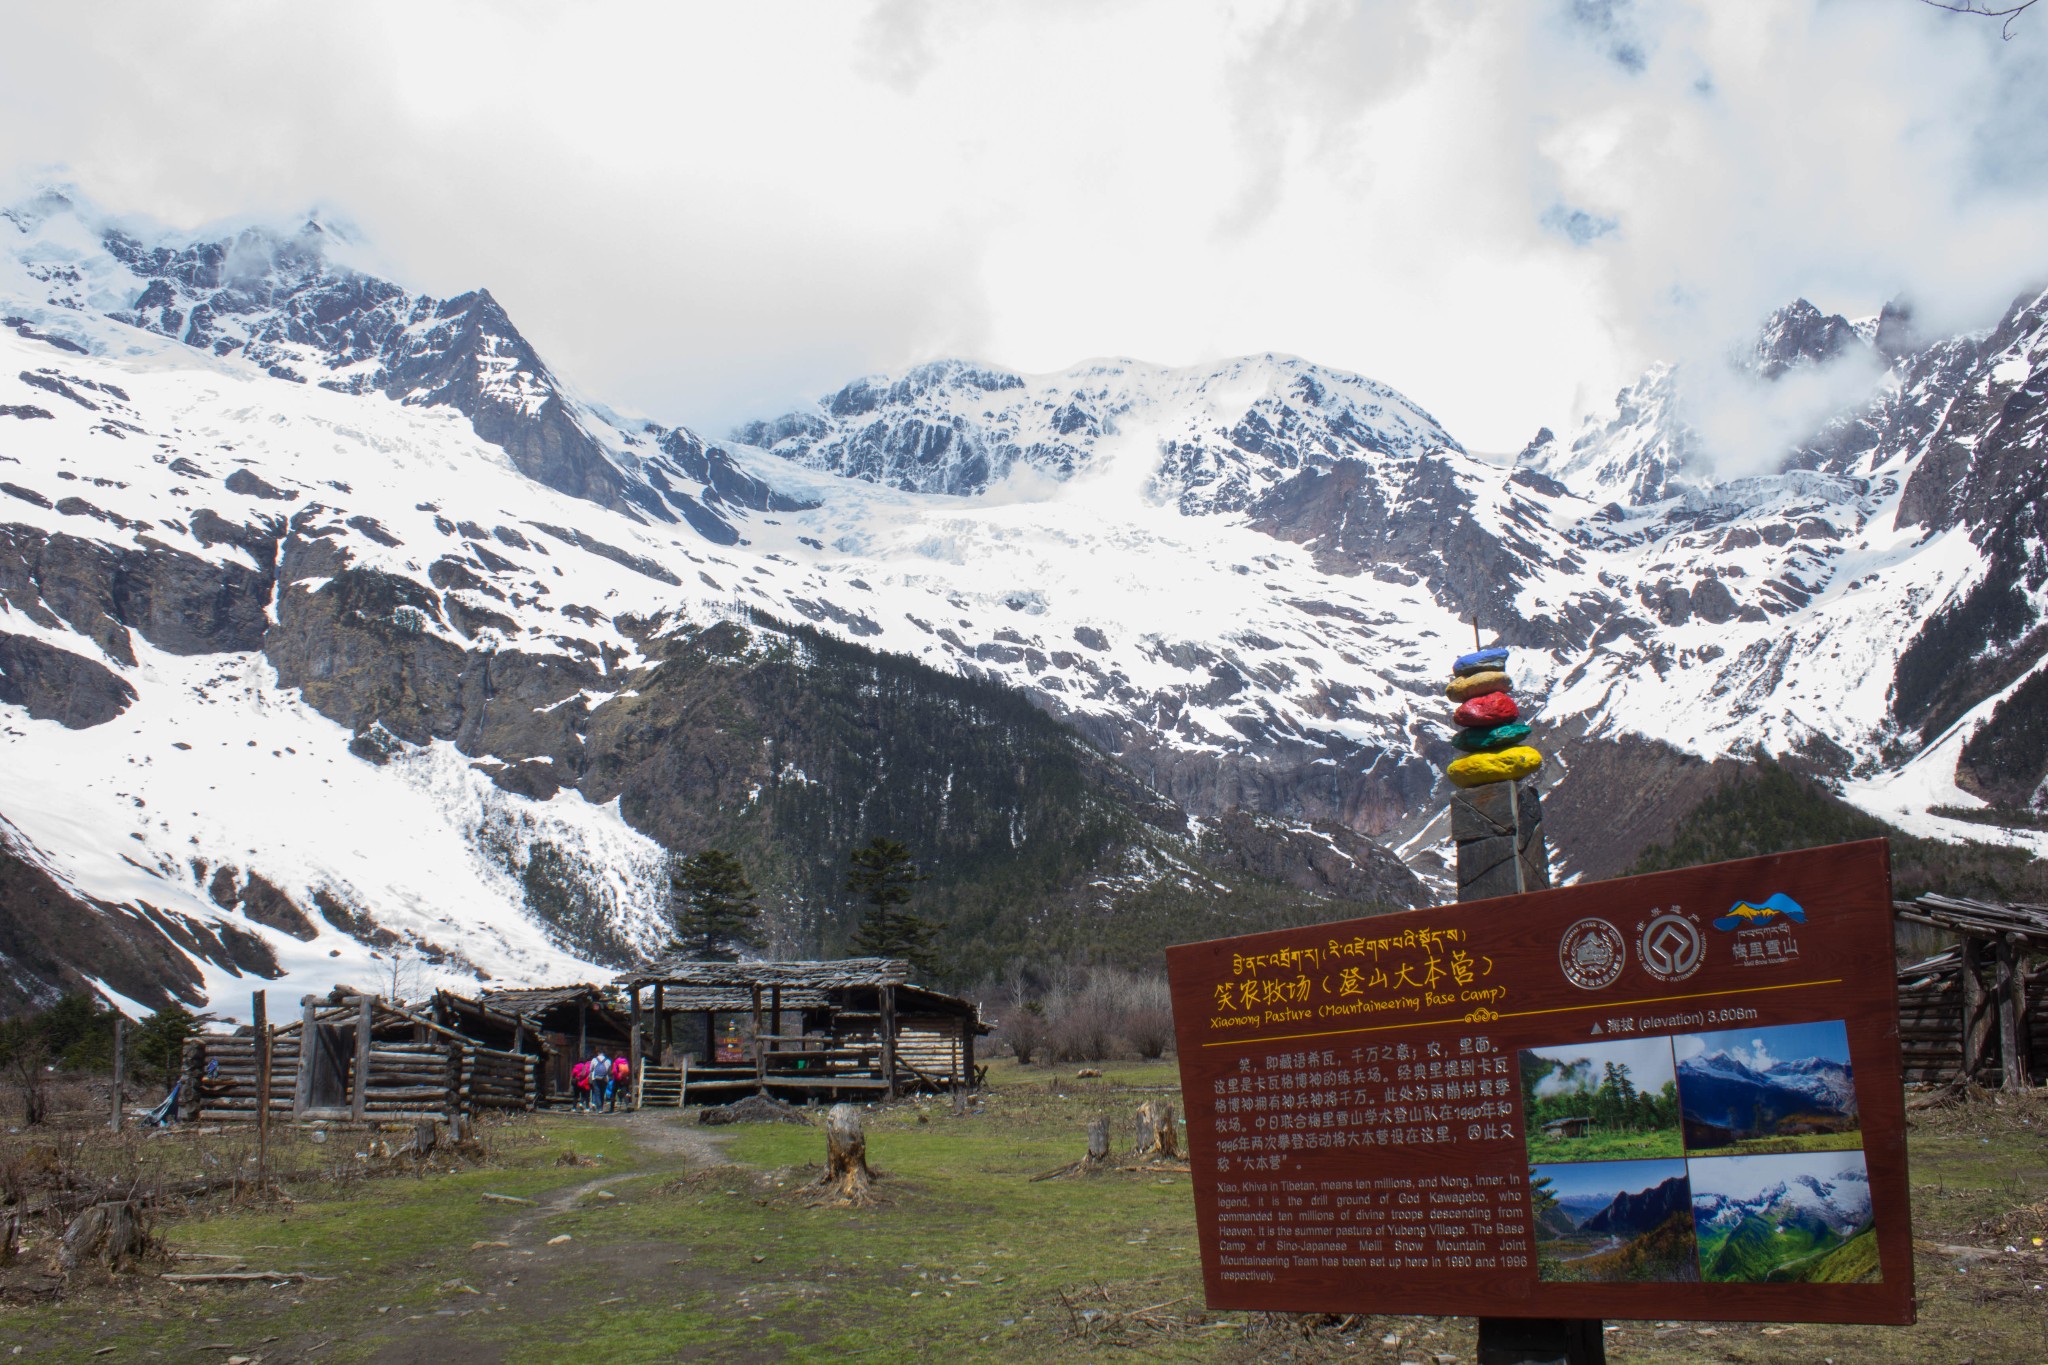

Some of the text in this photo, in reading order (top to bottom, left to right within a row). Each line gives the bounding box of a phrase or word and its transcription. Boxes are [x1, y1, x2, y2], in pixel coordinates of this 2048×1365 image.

[1732, 937, 1800, 961] 梅里雪山
[1210, 985, 1506, 1029] Xiaonong Pasture (Mountaineering Base Camp)
[1607, 1007, 1758, 1033] 海拔 (elevation) 3,608m
[1217, 1174, 1520, 1193] Xiao, Khiva in Tibetan, means ten millions, and Nong, inner. In
[1218, 1190, 1522, 1209] legend, it is the drill ground of God Kawagebo, who
[1218, 1207, 1523, 1222] commanded ten millions of divine troops descending from
[1219, 1223, 1525, 1238] Heaven. It is the summer pasture of Yubeng Village. The Base
[1219, 1239, 1526, 1253] Camp of Sino-Japanese Meili Snow Mountain Joint
[1220, 1255, 1528, 1270] Mountaineering Team has been set up here in 1990 and 1996
[1220, 1269, 1276, 1282] respectively.
